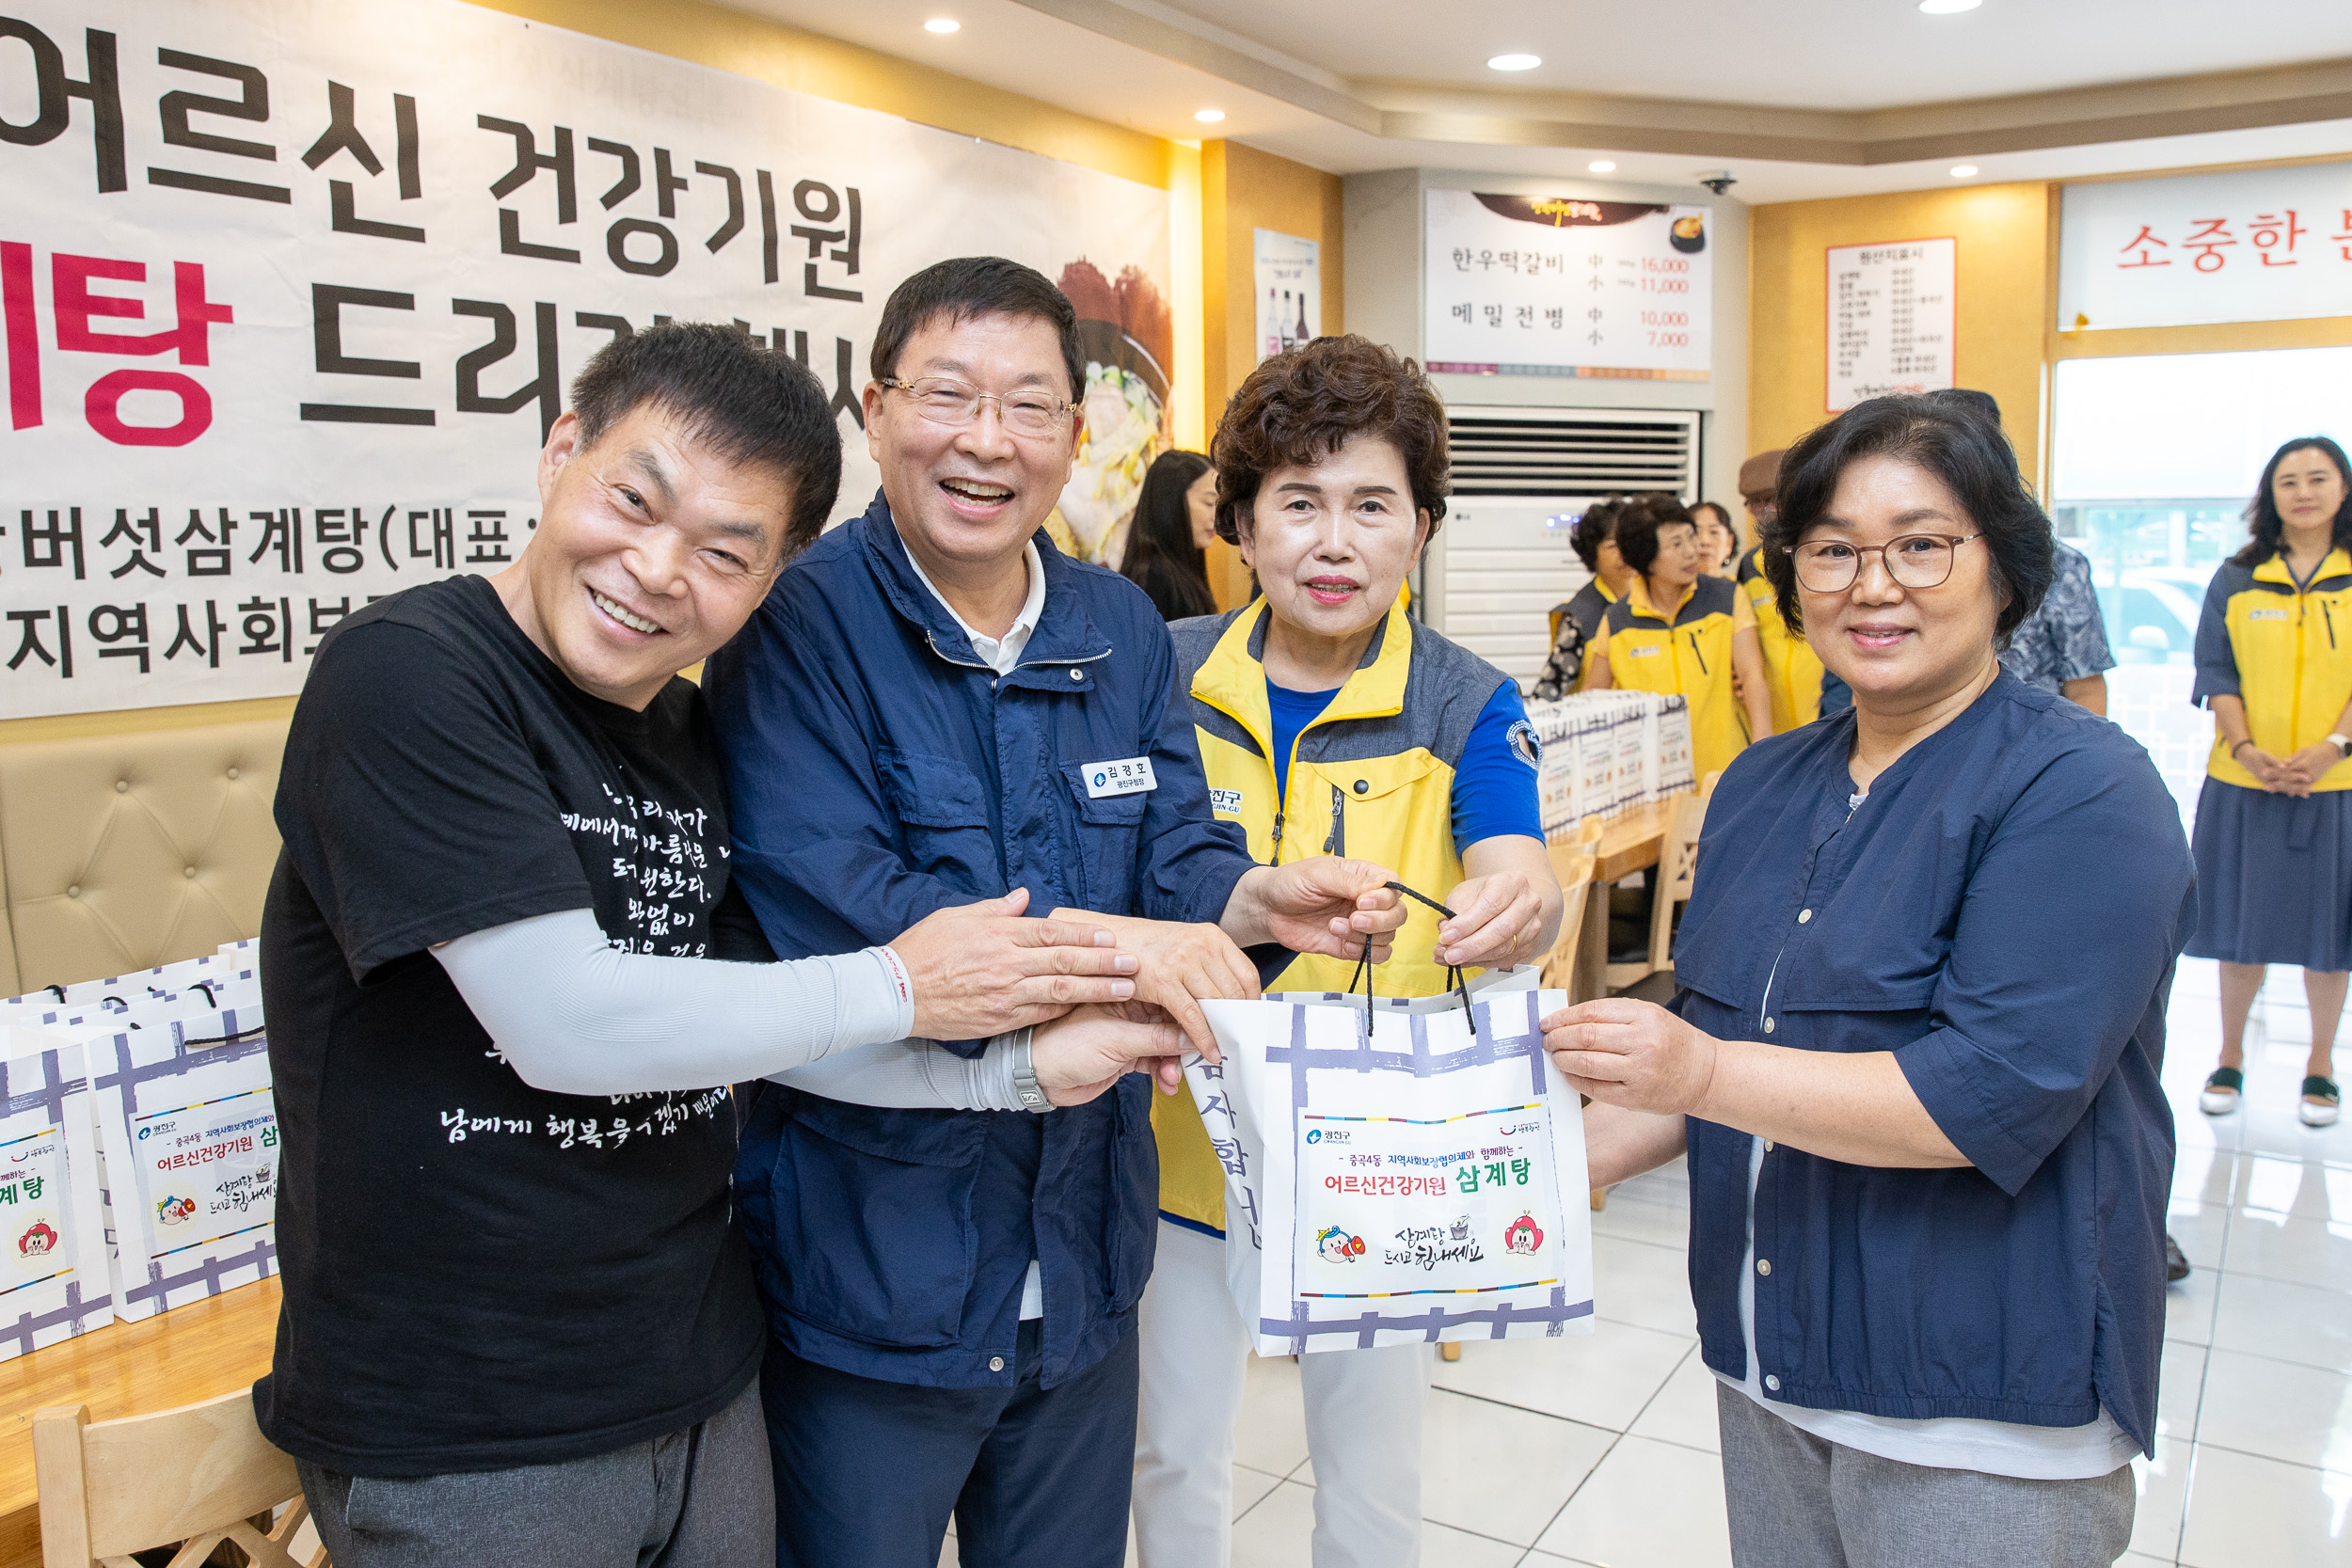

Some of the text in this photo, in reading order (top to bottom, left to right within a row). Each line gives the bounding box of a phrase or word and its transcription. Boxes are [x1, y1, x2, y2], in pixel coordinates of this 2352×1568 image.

[0, 16, 865, 304] 어르신 건강기원
[2117, 209, 2307, 273] 소중한
[1452, 246, 1564, 276] 한우떡갈비
[1641, 257, 1690, 274] 16,000
[1641, 277, 1690, 294] 11,000
[1641, 310, 1690, 327] 10,000
[0, 241, 234, 448] 탕
[1647, 330, 1690, 348] 7,000
[1116, 777, 1145, 788] 광진구청장
[1209, 789, 1241, 805] 진구
[440, 1108, 532, 1143] 남에게
[1324, 1130, 1351, 1140] 광진구
[176, 1132, 201, 1148] 중곡4동
[157, 1135, 253, 1171] 어르신건강기원
[1349, 1146, 1515, 1169] 중곡4동 지역사회보장협의체와 함께하는
[0, 1169, 26, 1181] 께하는
[1325, 1157, 1532, 1196] 어르신건강기원 삼계탕
